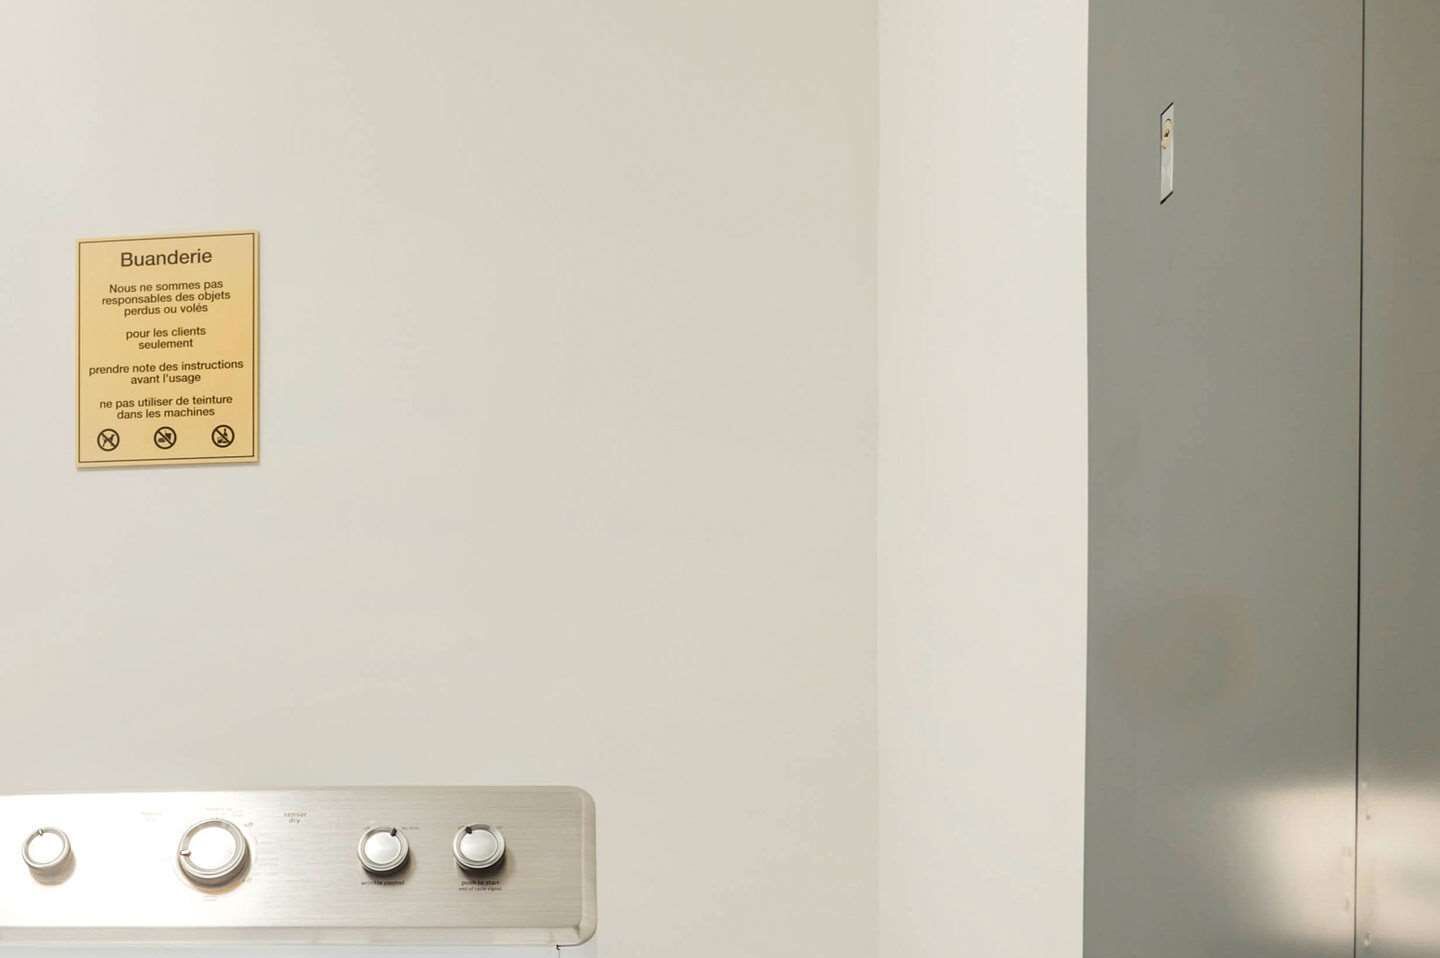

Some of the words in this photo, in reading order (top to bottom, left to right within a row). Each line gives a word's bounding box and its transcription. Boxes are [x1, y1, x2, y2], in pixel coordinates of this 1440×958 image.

[121, 248, 212, 267] Buanderie
[110, 283, 137, 294] Nous
[140, 283, 153, 292] ne
[156, 281, 201, 292] sommes
[204, 280, 224, 292] pas
[102, 294, 173, 307] responsables
[175, 292, 195, 302] des
[198, 290, 231, 303] objets
[124, 305, 161, 318] perdus
[164, 305, 177, 314] ou
[180, 303, 208, 313] volés
[126, 329, 151, 340] pour
[153, 327, 168, 338] les
[171, 326, 206, 337] clients
[138, 339, 194, 350] seulement
[89, 364, 129, 376] prendre
[133, 363, 156, 374] note
[159, 362, 178, 372] des
[181, 360, 244, 372] instructions
[131, 374, 160, 385] avant
[163, 373, 201, 385] l'usage
[100, 400, 112, 409] ne
[115, 399, 135, 410] pas
[138, 397, 172, 408] utiliser
[176, 396, 190, 406] de
[192, 395, 233, 405] teinture
[117, 409, 143, 420] dans
[146, 408, 160, 418] les
[164, 406, 215, 417] machines
